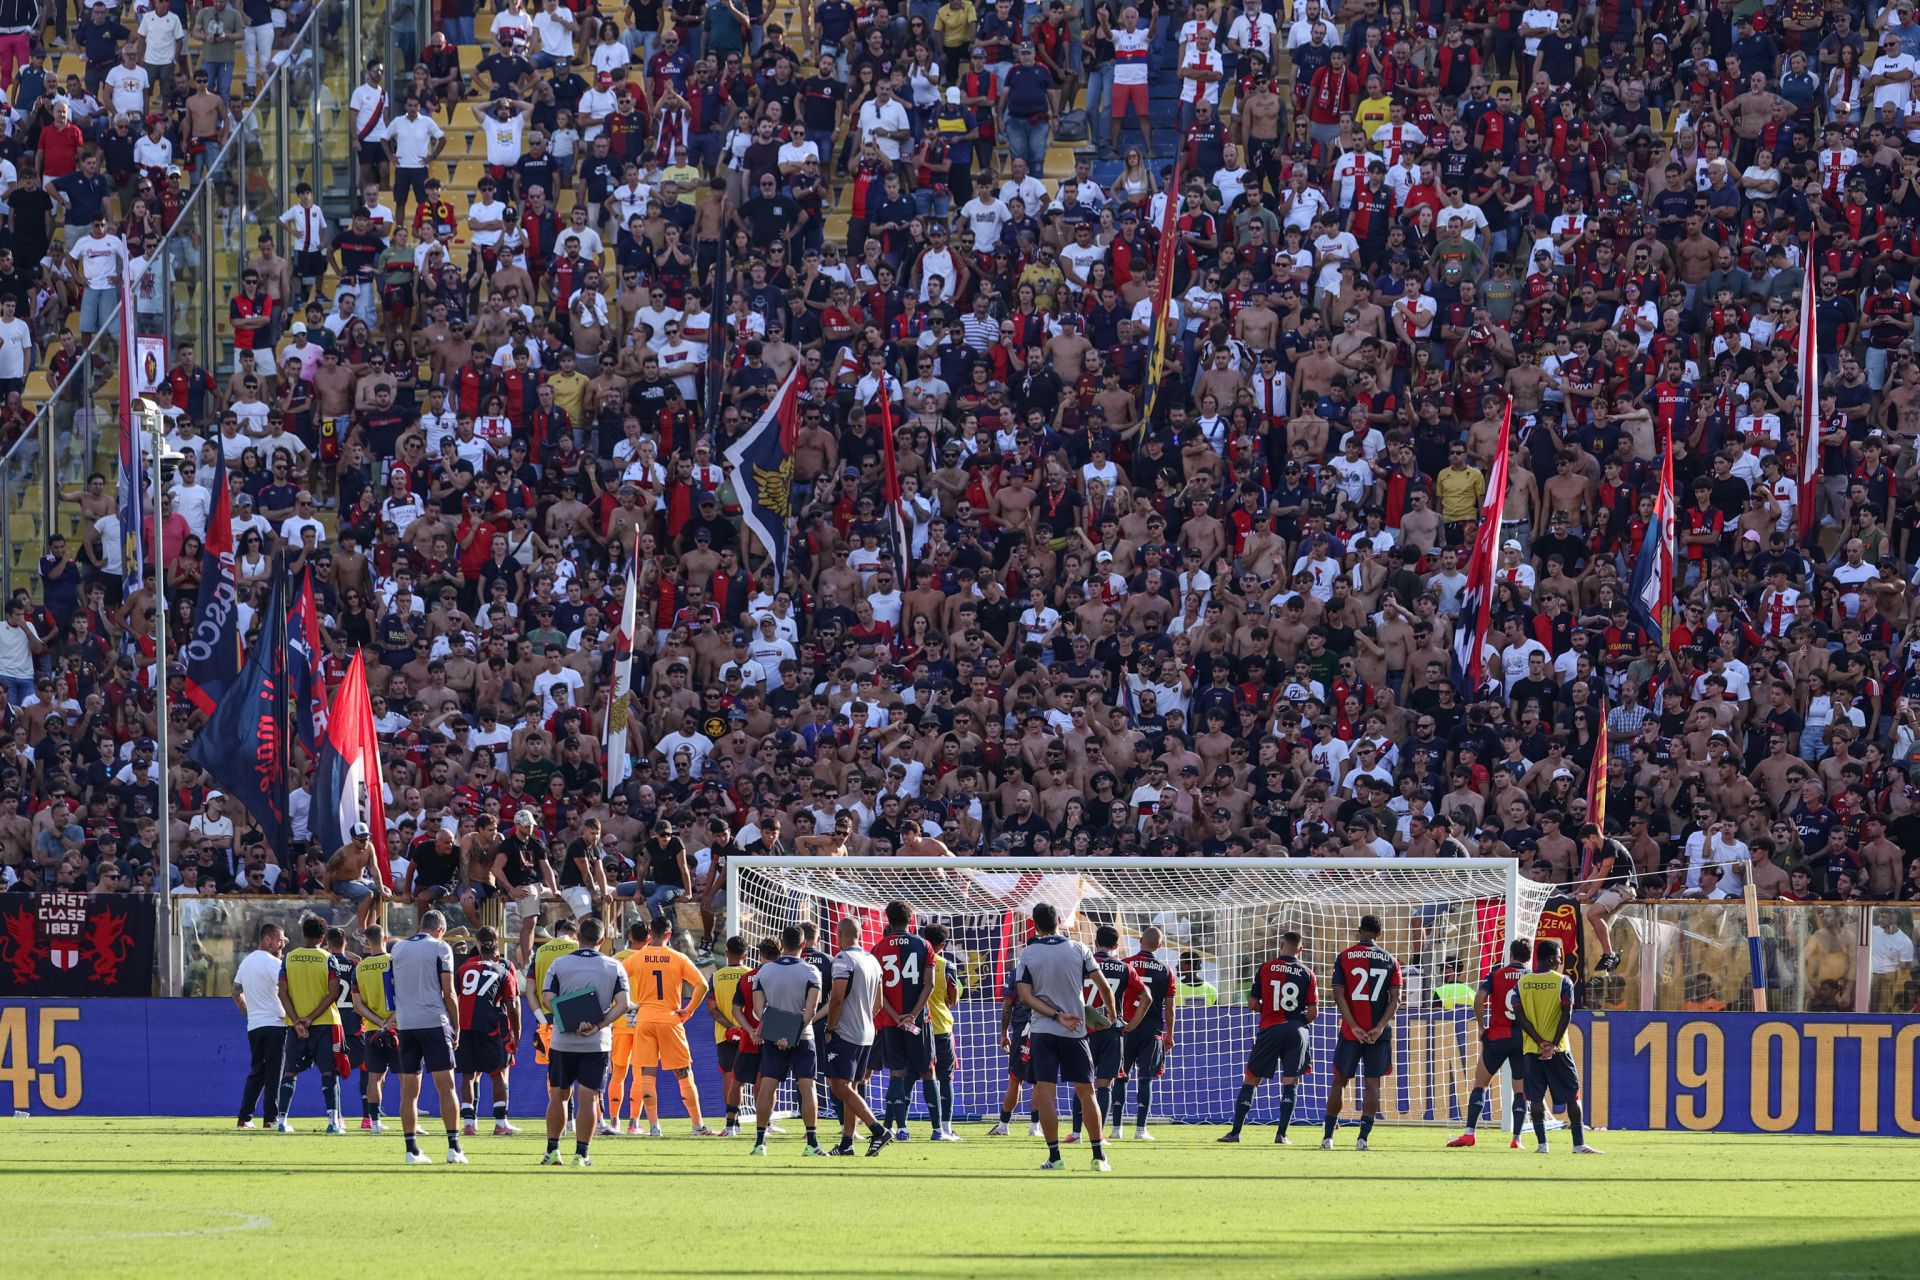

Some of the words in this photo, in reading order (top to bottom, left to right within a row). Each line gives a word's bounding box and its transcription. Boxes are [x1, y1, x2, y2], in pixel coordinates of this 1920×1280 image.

[660, 66, 681, 74] Costa
[41, 894, 87, 907] FIRST
[39, 908, 86, 921] CLASS
[45, 922, 79, 935] 1893
[889, 938, 909, 946] OTOA
[644, 955, 670, 963] BIJLOW
[1347, 951, 1390, 962] MARCANDALLI
[881, 952, 920, 988] 34
[462, 968, 499, 997] 97
[652, 970, 664, 1000] 1
[1350, 967, 1388, 1002] 27
[1270, 979, 1300, 1012] 18
[0, 1006, 83, 1111] 45
[1634, 1020, 1725, 1131] 19
